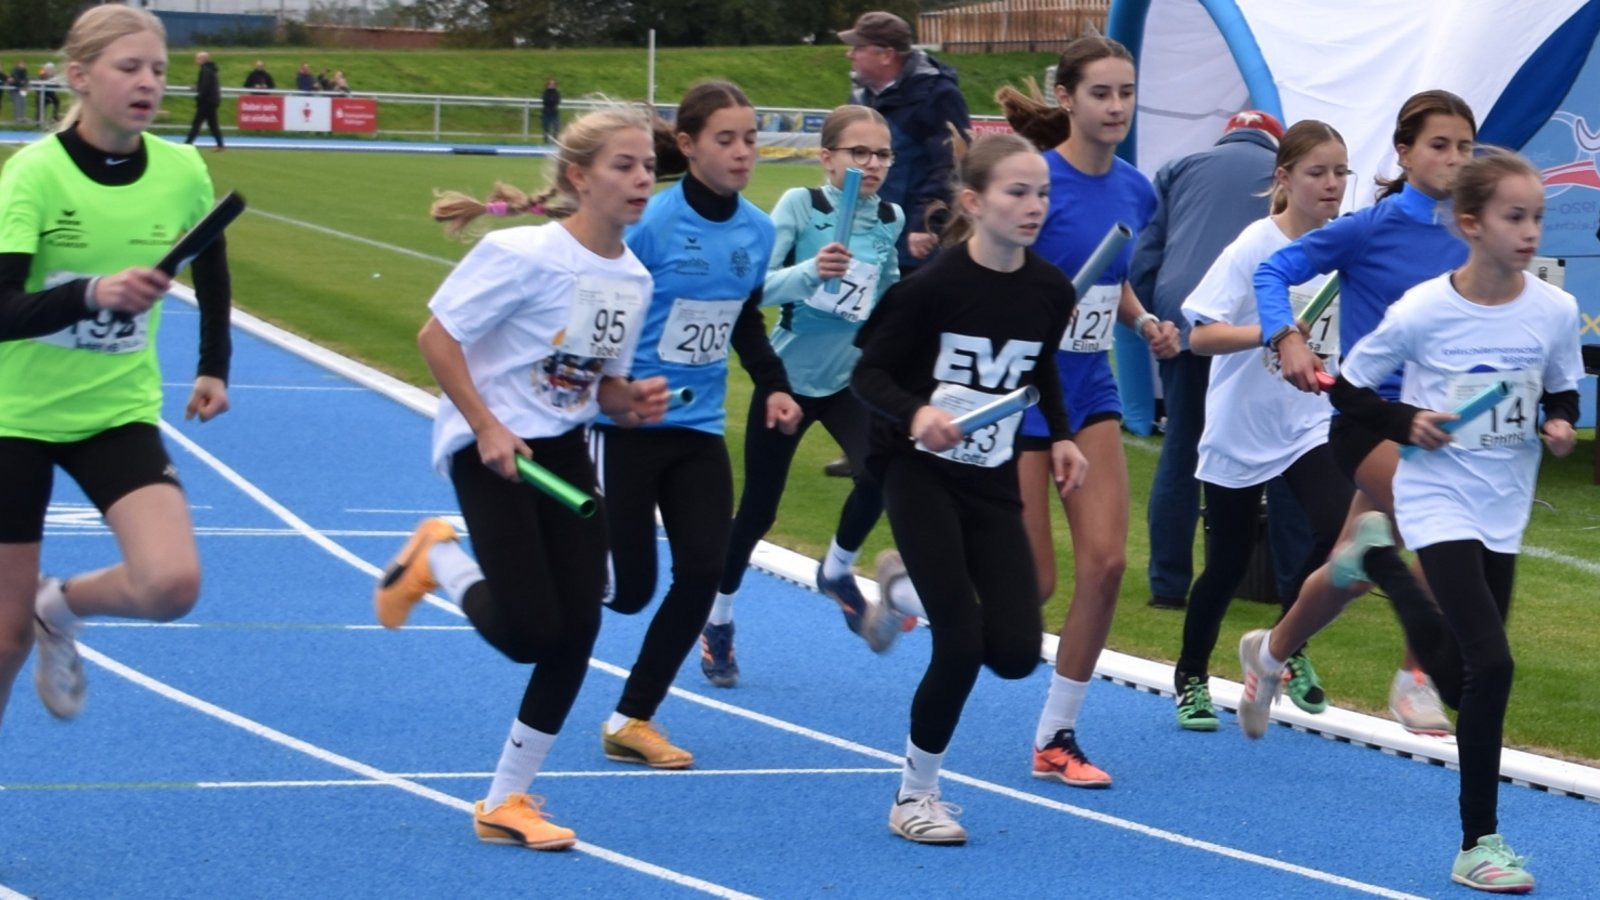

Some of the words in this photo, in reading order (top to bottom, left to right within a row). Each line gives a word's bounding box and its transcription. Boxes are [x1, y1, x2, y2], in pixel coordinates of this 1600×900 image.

[592, 308, 626, 344] 95
[676, 322, 731, 352] 203
[1070, 309, 1113, 340] 127
[933, 332, 1043, 389] EVF
[1490, 396, 1528, 434] 14
